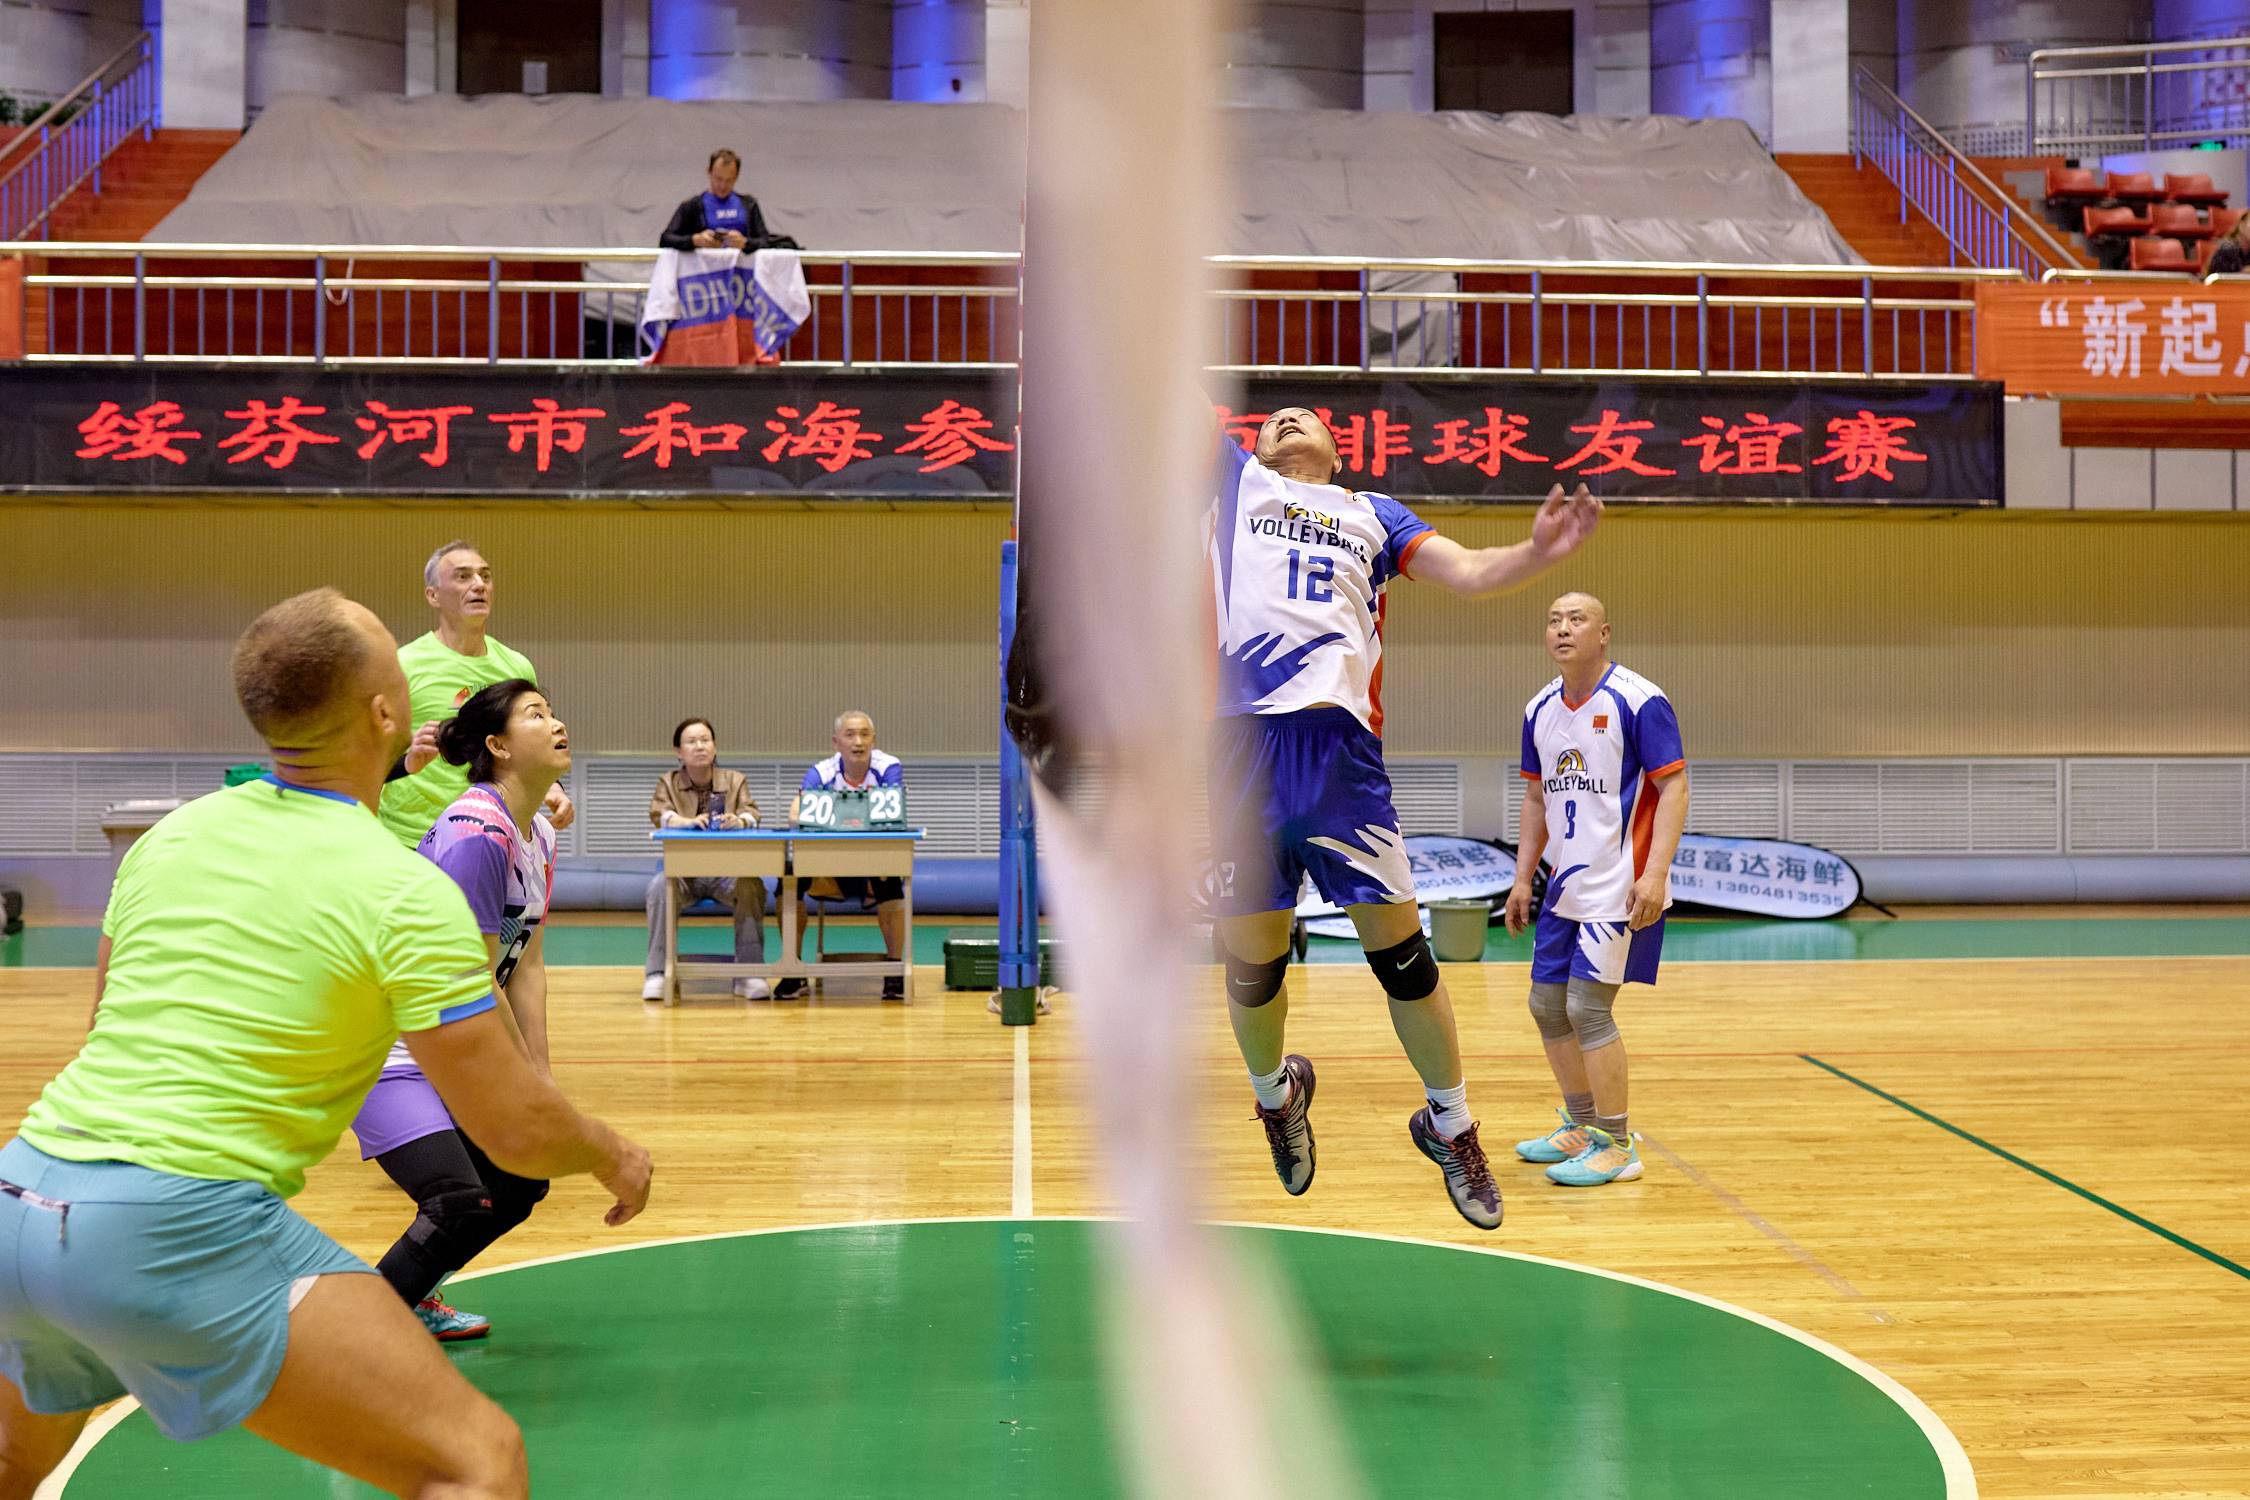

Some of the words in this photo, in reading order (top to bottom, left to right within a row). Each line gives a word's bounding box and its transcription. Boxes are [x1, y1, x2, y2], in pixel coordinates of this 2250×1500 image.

[1250, 518, 1367, 564] VOLLEYBALL
[1287, 548, 1334, 603] 12
[870, 789, 902, 819] 23
[1715, 880, 1845, 908] 13804813535
